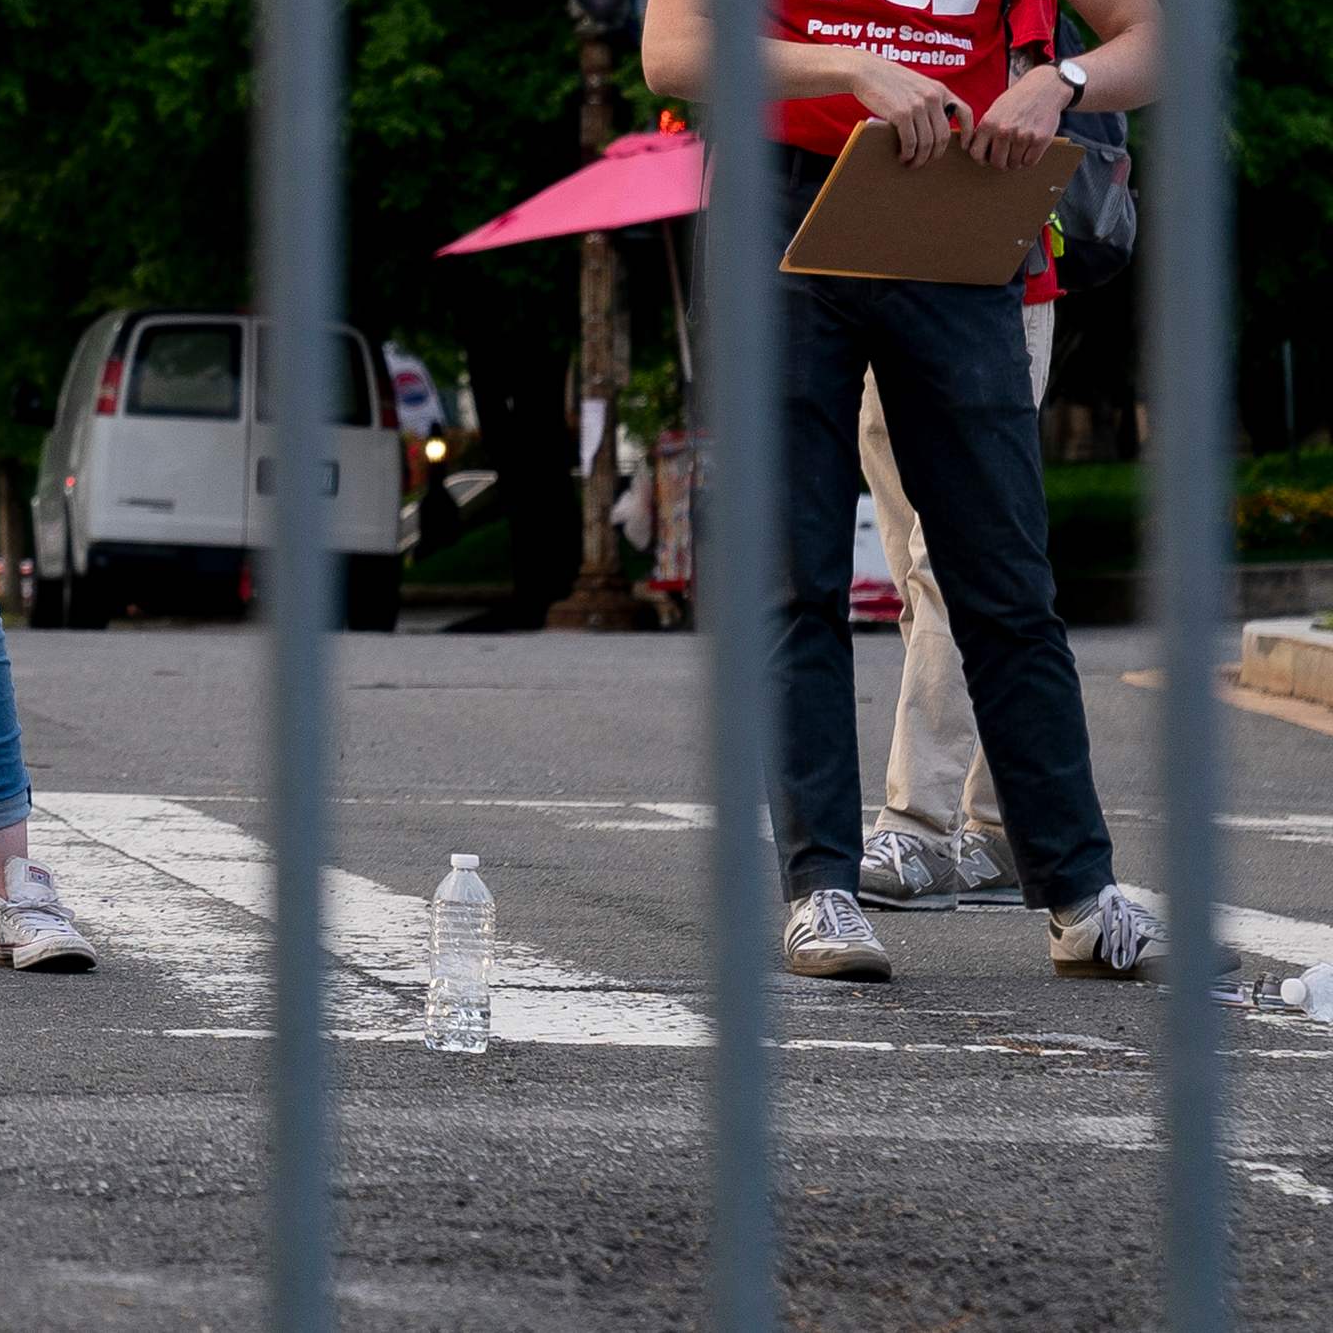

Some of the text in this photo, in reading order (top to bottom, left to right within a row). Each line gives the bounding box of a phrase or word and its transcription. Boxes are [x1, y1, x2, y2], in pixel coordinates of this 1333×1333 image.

[807, 19, 863, 39] Party
[866, 21, 896, 40] for
[870, 43, 966, 66] Liberation
